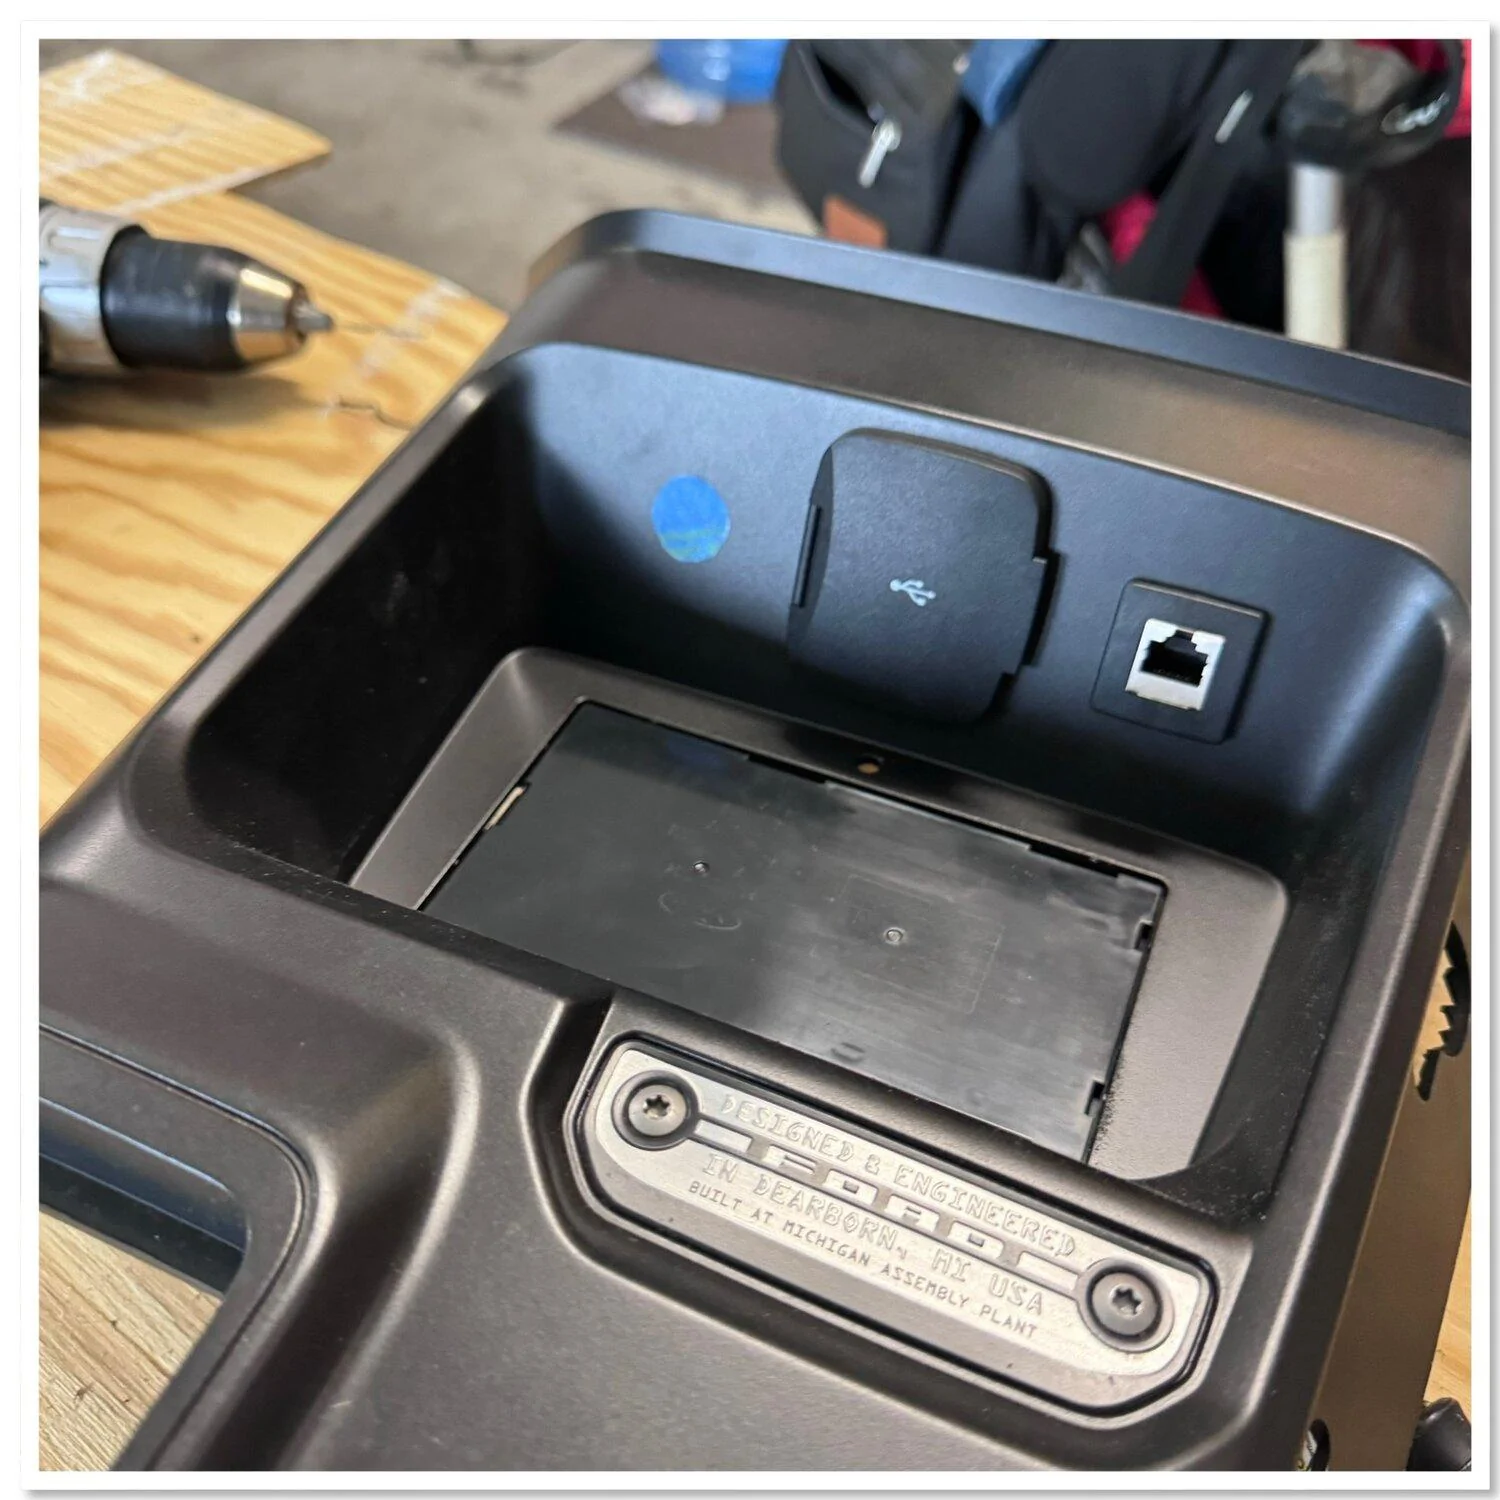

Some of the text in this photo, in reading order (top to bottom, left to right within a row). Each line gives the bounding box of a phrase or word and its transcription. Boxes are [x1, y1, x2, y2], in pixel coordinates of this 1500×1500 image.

[701, 1151, 1047, 1317] IN DEARBORN, MI USA
[721, 1094, 1077, 1259] DESIGNED & ENGINEERED
[762, 1142, 1007, 1266] FORD
[687, 1179, 1040, 1341] BUILT AT MICHIGAN ASSEMBLY PLANT
